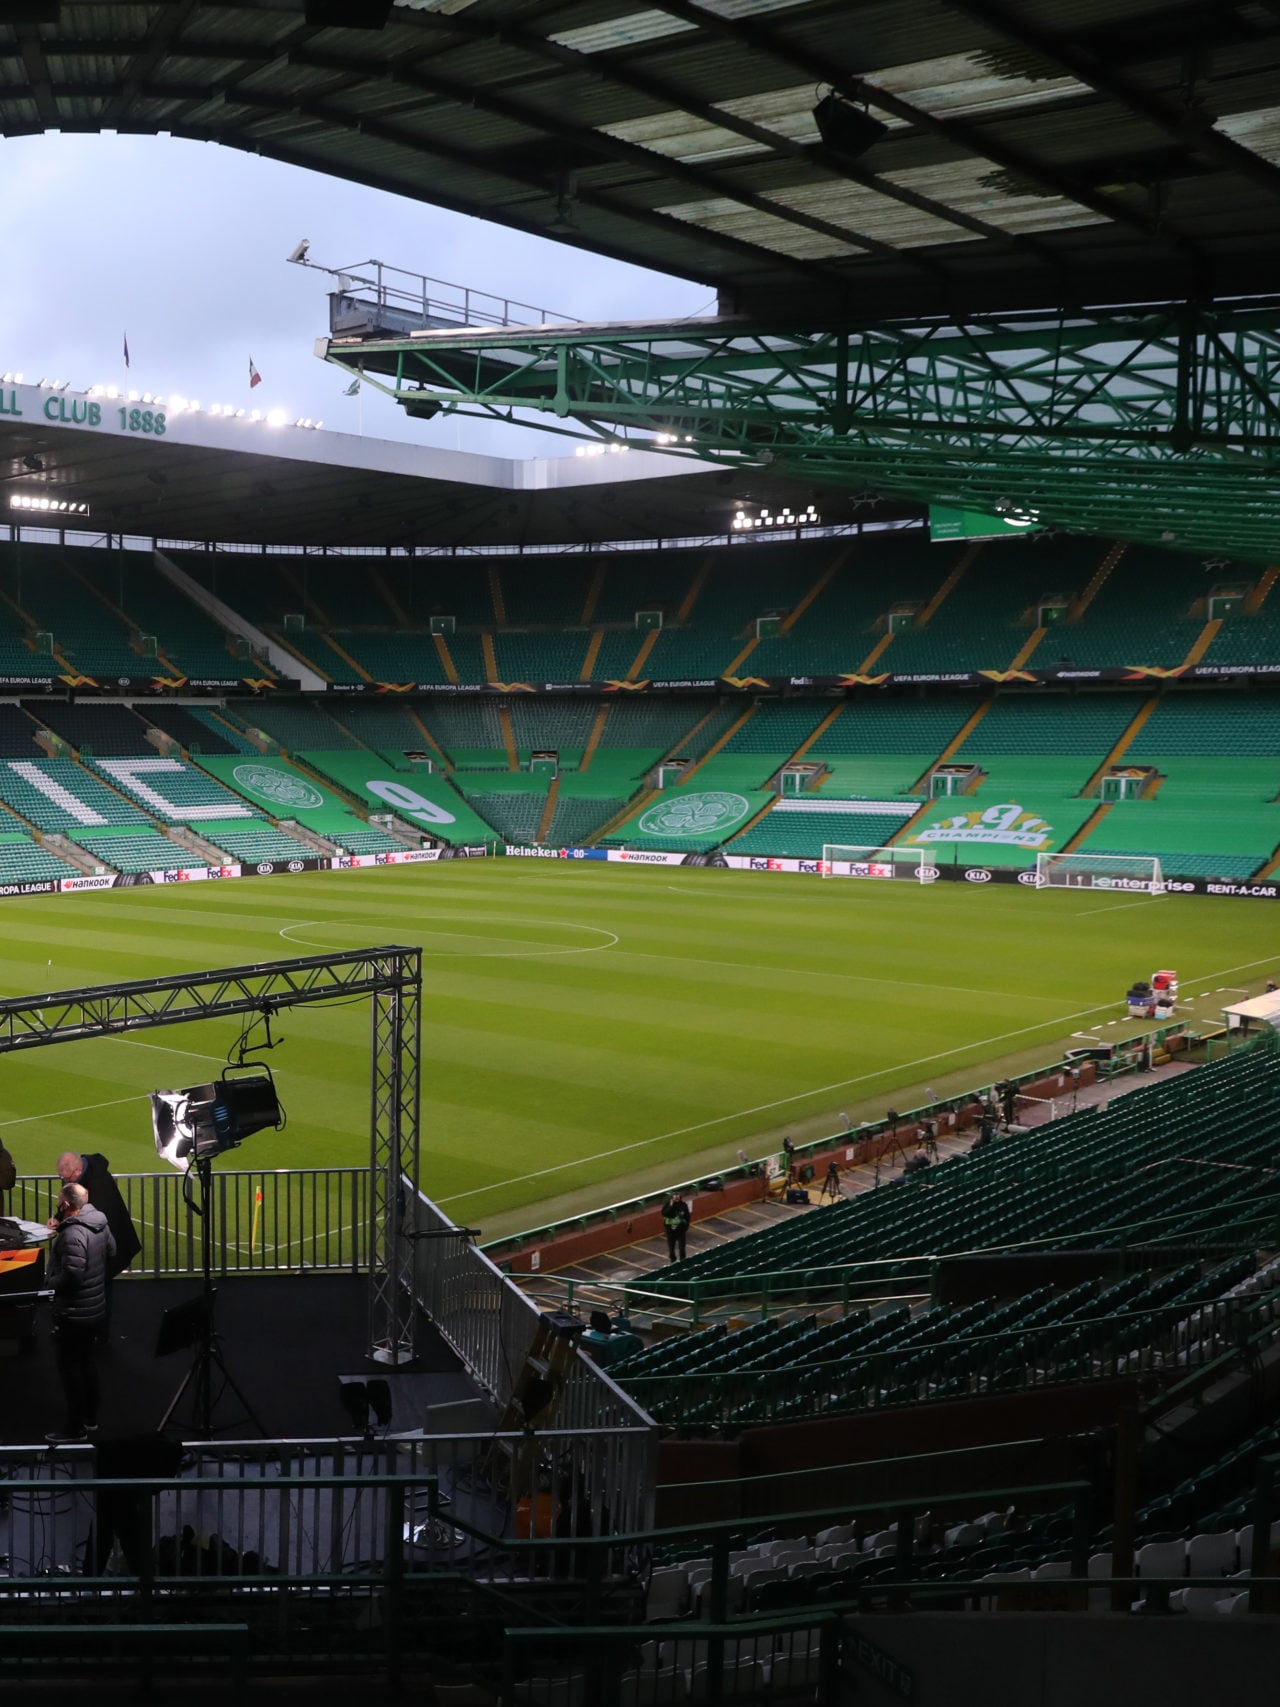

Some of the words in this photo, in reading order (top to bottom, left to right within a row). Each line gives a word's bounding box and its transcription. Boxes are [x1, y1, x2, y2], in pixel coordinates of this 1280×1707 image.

[43, 396, 102, 426] CLUB
[118, 407, 167, 435] 1888
[938, 673, 969, 681] LEAGUE
[1220, 666, 1255, 674] EUROPA
[366, 780, 456, 824] 9
[980, 804, 1024, 831] 9
[375, 852, 396, 865] FedEx
[505, 845, 558, 859] Heineken
[339, 855, 361, 868] FedEx
[749, 857, 782, 871] FedEx
[798, 860, 832, 874] FedEx
[163, 870, 190, 882] FedEx
[207, 866, 233, 878] FedEx
[849, 863, 884, 877] FedEx
[21, 881, 52, 894] LEAGUE
[1096, 876, 1196, 892] enterprise
[1207, 882, 1277, 897] RENT-A-CAR
